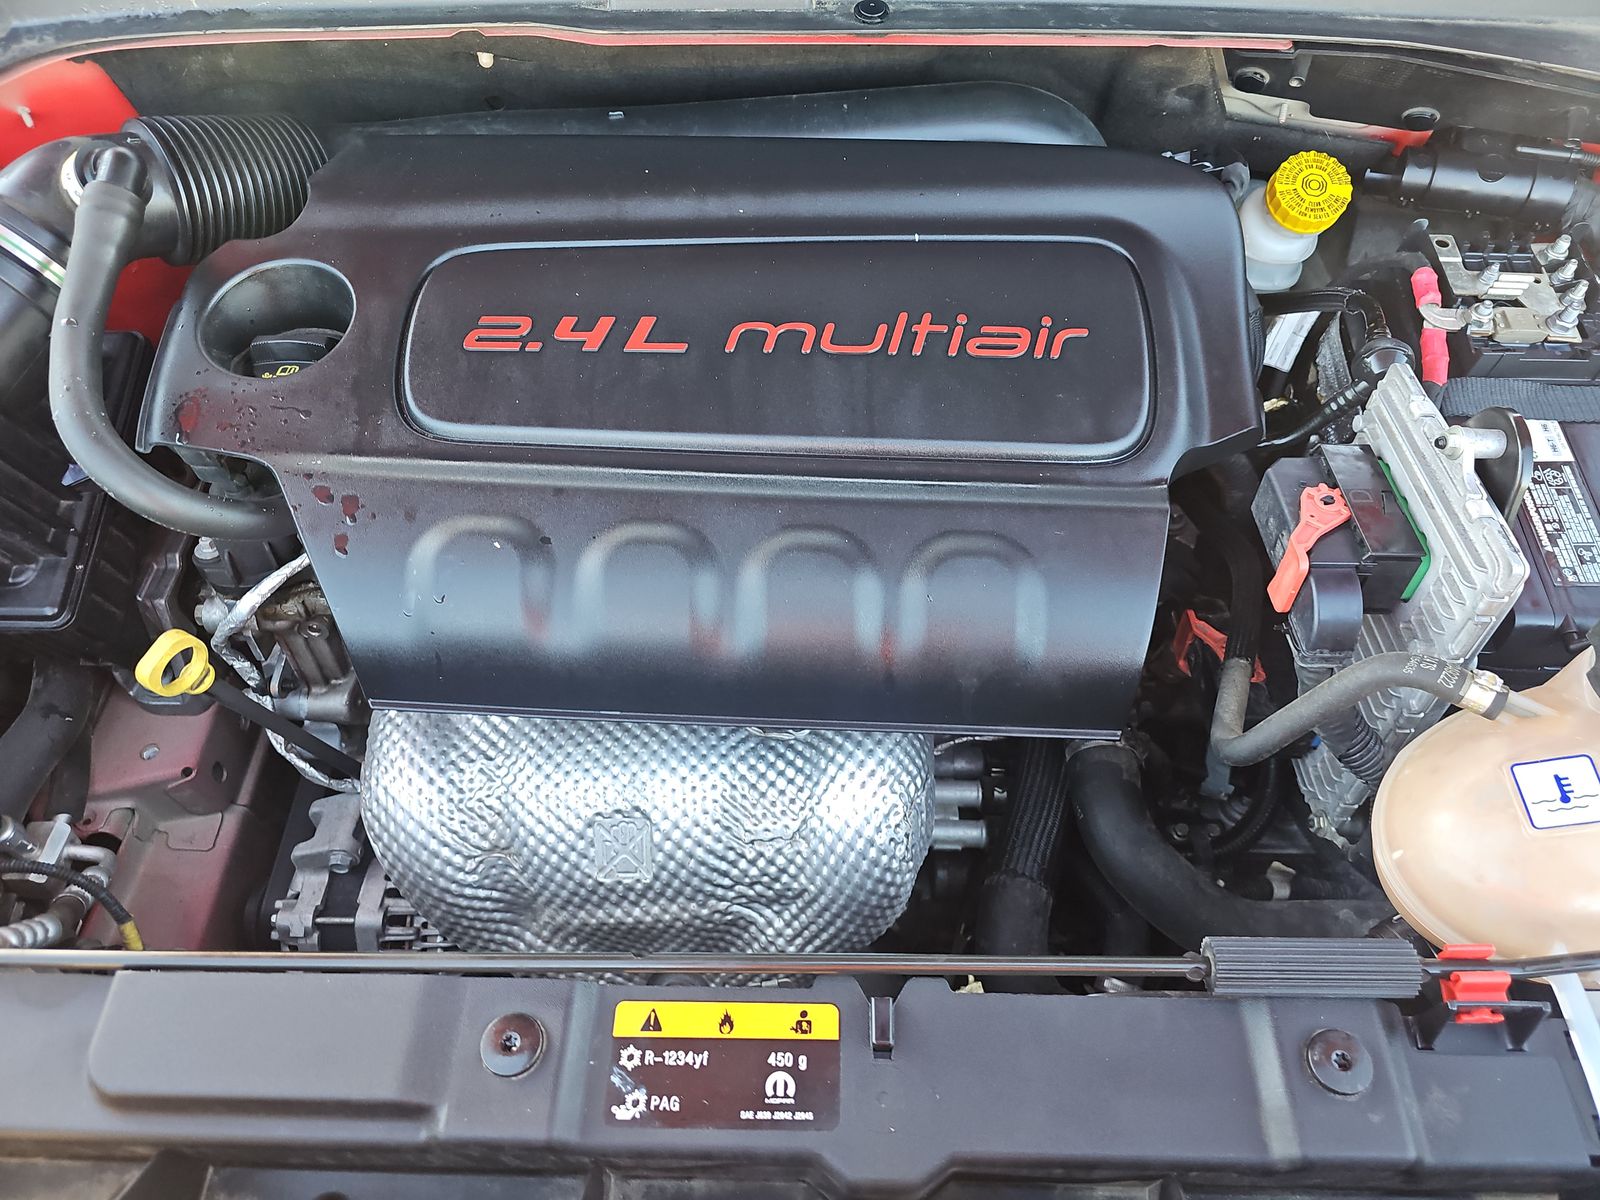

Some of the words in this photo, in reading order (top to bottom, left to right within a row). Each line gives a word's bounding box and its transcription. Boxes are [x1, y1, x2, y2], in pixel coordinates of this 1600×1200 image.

[724, 311, 1090, 359] multiair
[644, 1049, 709, 1069] R-1234yf
[767, 1051, 793, 1067] 450
[797, 1054, 808, 1071] g
[649, 1095, 681, 1112] PAG
